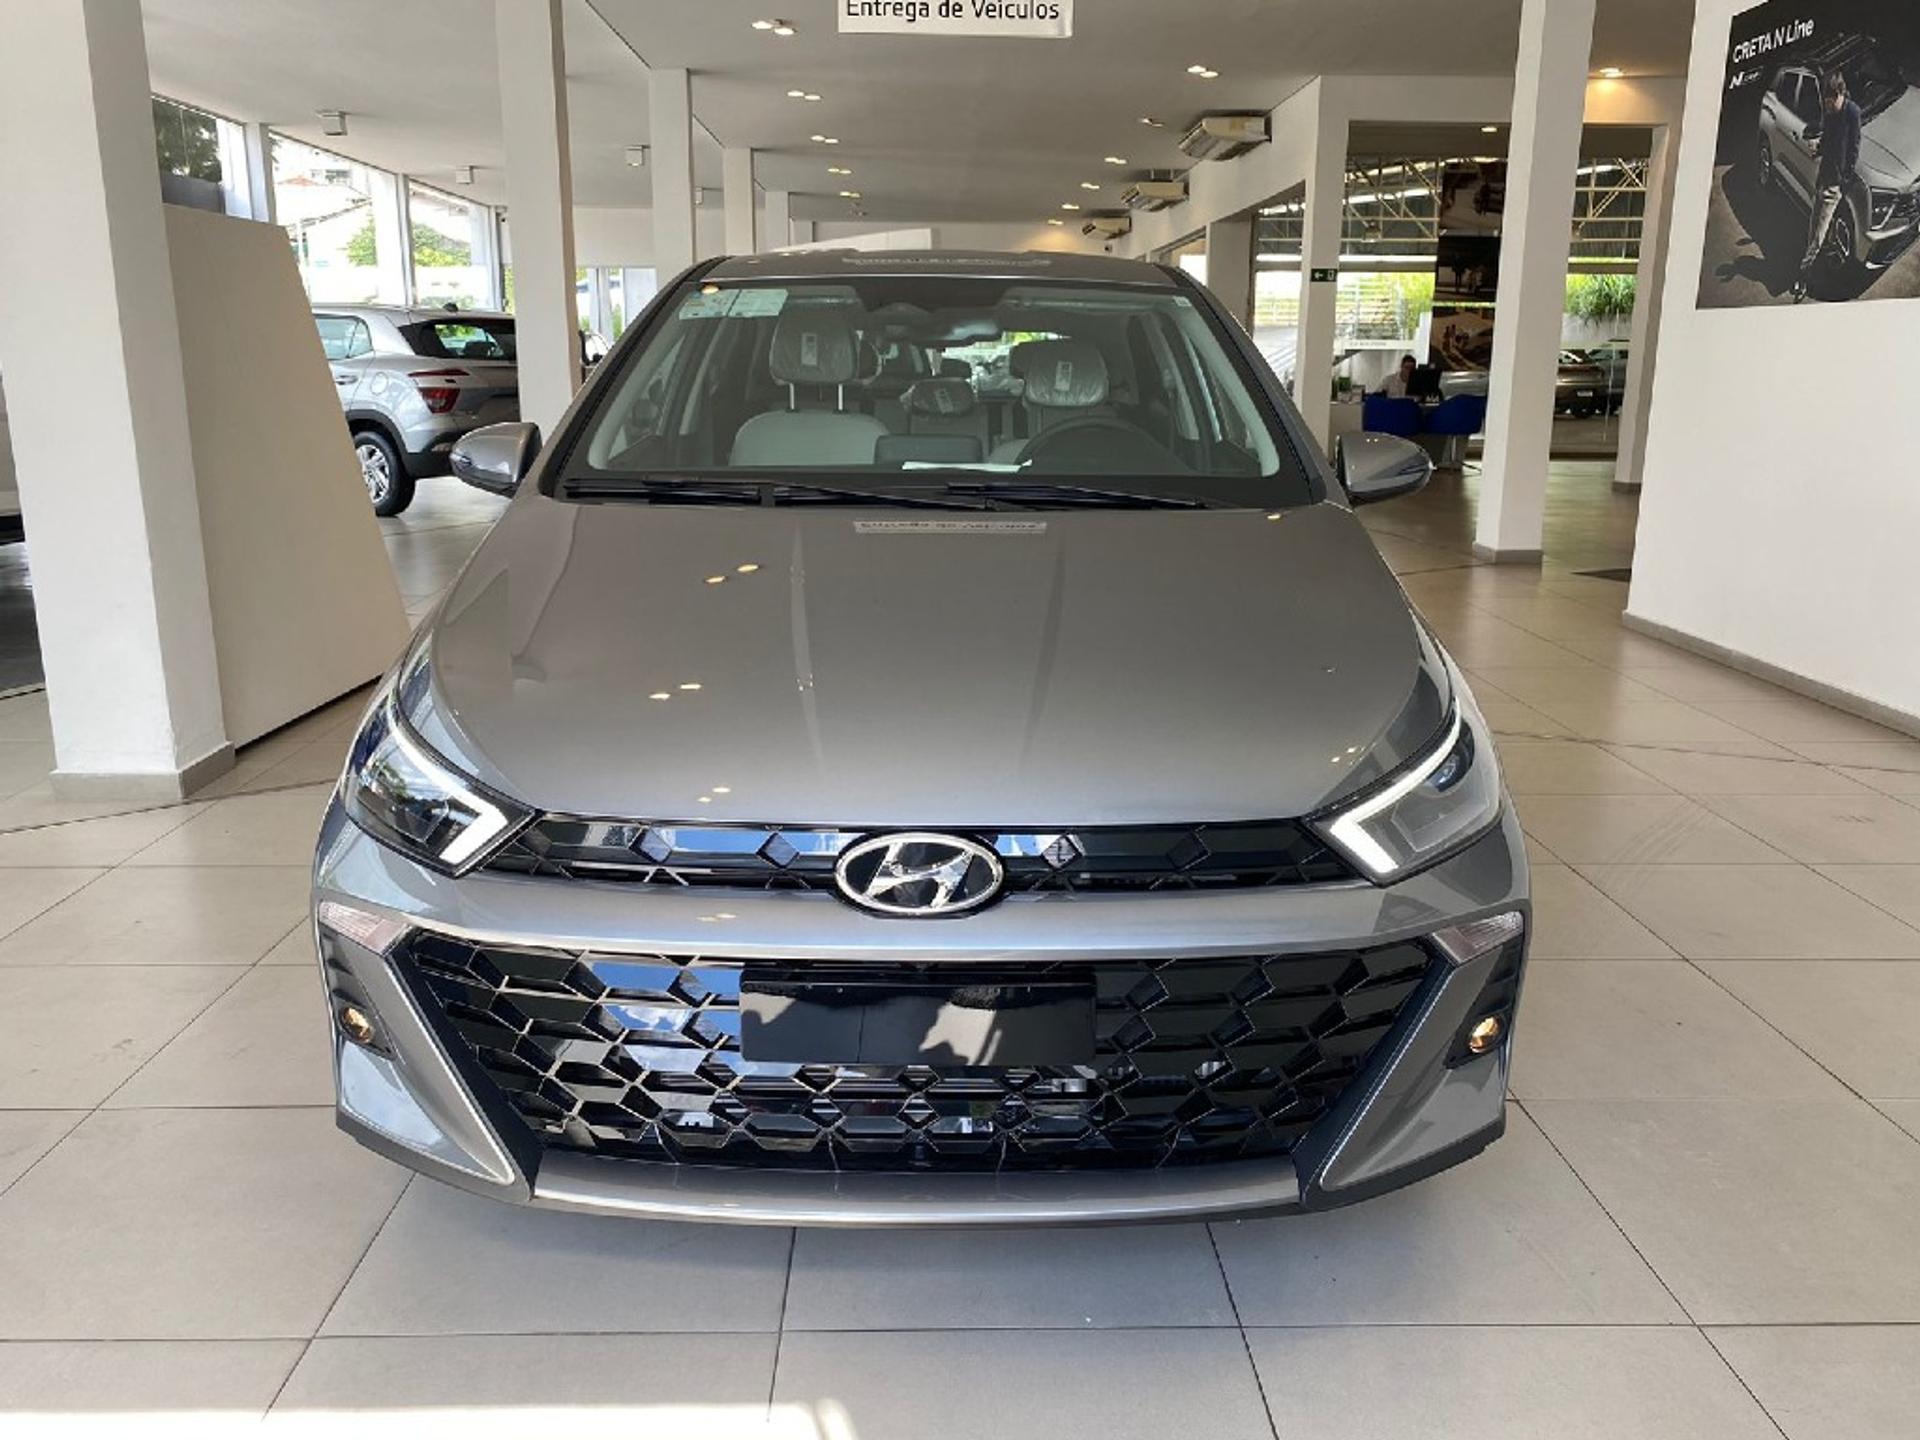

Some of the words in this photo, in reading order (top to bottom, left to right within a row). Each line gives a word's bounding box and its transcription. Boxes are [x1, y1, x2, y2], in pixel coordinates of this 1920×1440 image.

[846, 0, 930, 22] Entrega
[938, 0, 964, 18] de
[1732, 32, 1772, 63] CRETA
[1773, 26, 1786, 49] N
[1785, 19, 1815, 43] Line
